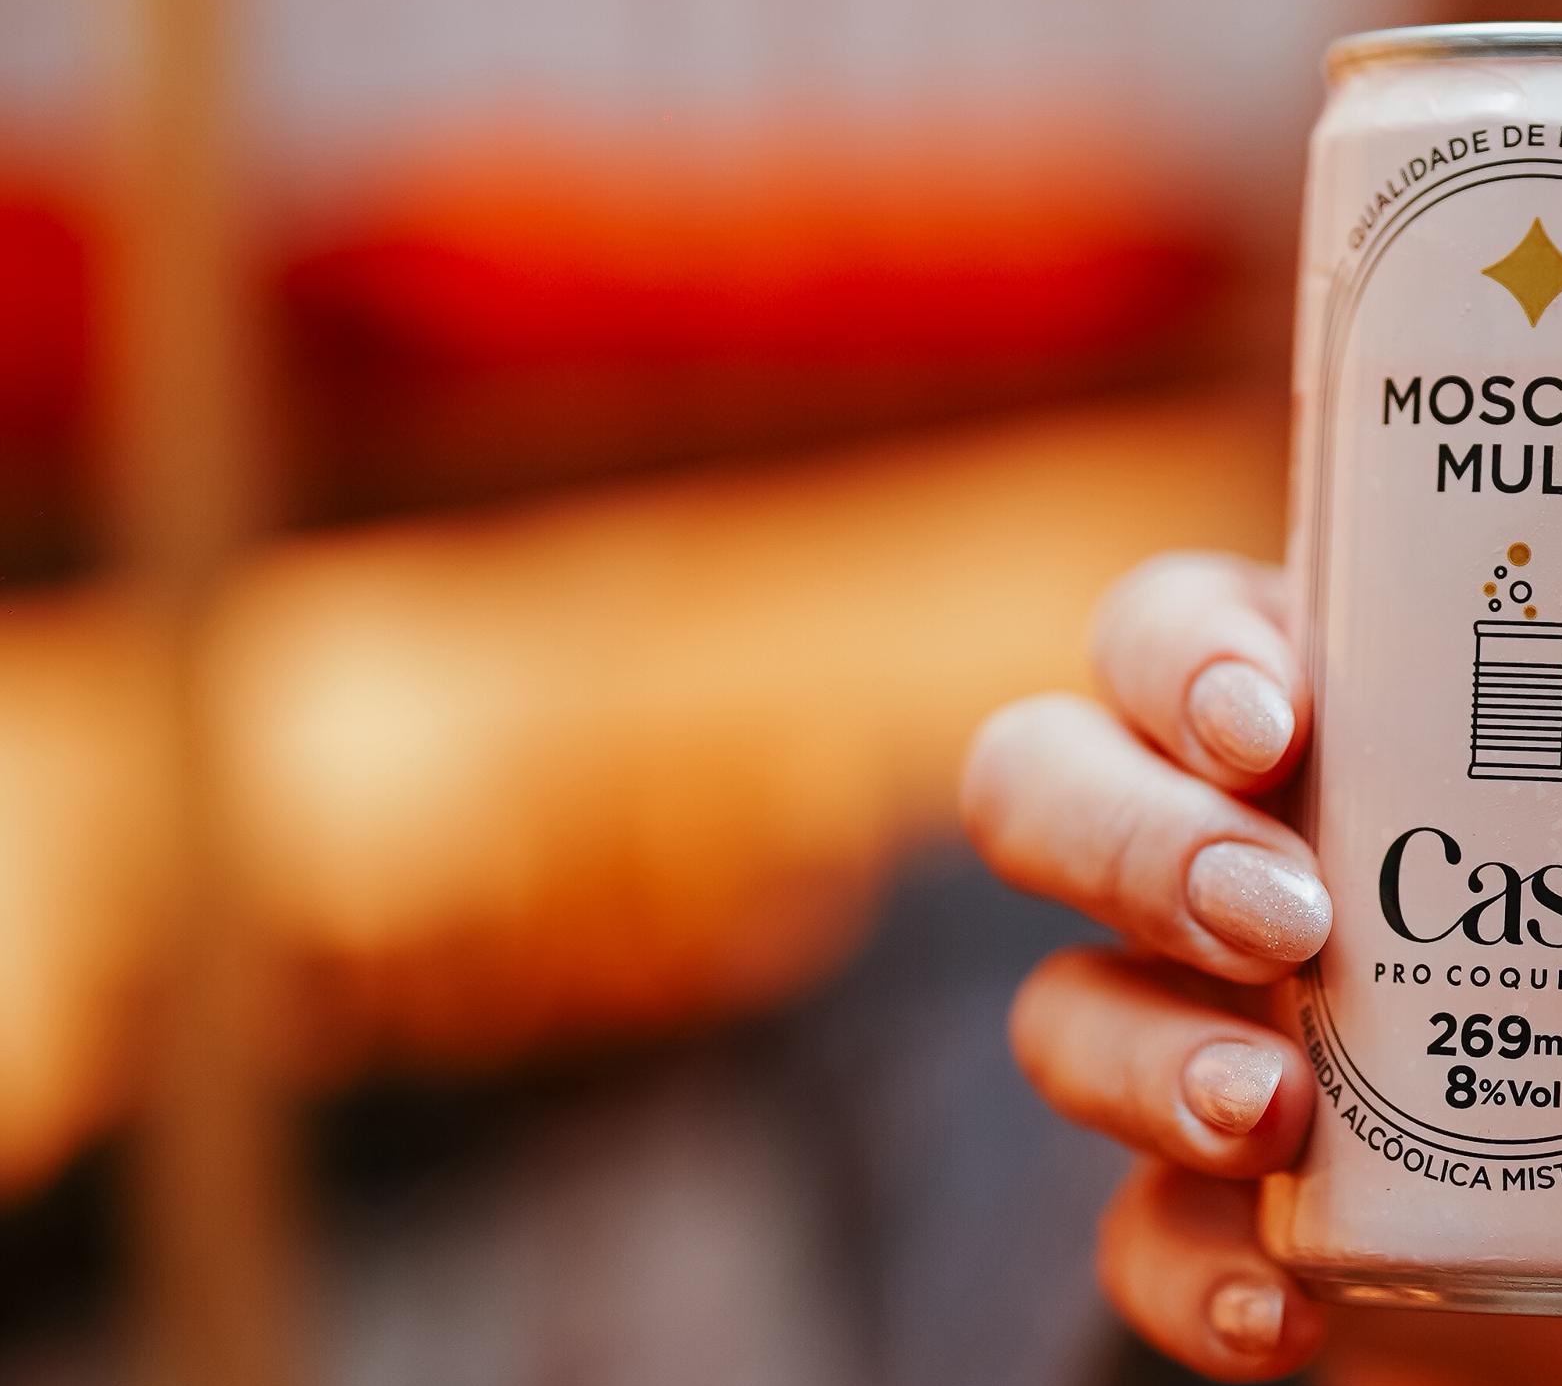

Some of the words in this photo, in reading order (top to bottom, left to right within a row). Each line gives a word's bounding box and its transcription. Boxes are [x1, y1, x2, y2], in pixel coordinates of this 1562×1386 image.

[1349, 129, 1490, 249] QUALIDADE
[1503, 124, 1545, 148] DE
[1375, 963, 1431, 984] PRO
[1445, 1065, 1561, 1109] 8%Vol
[1341, 1104, 1492, 1190] ALCÓOLICA
